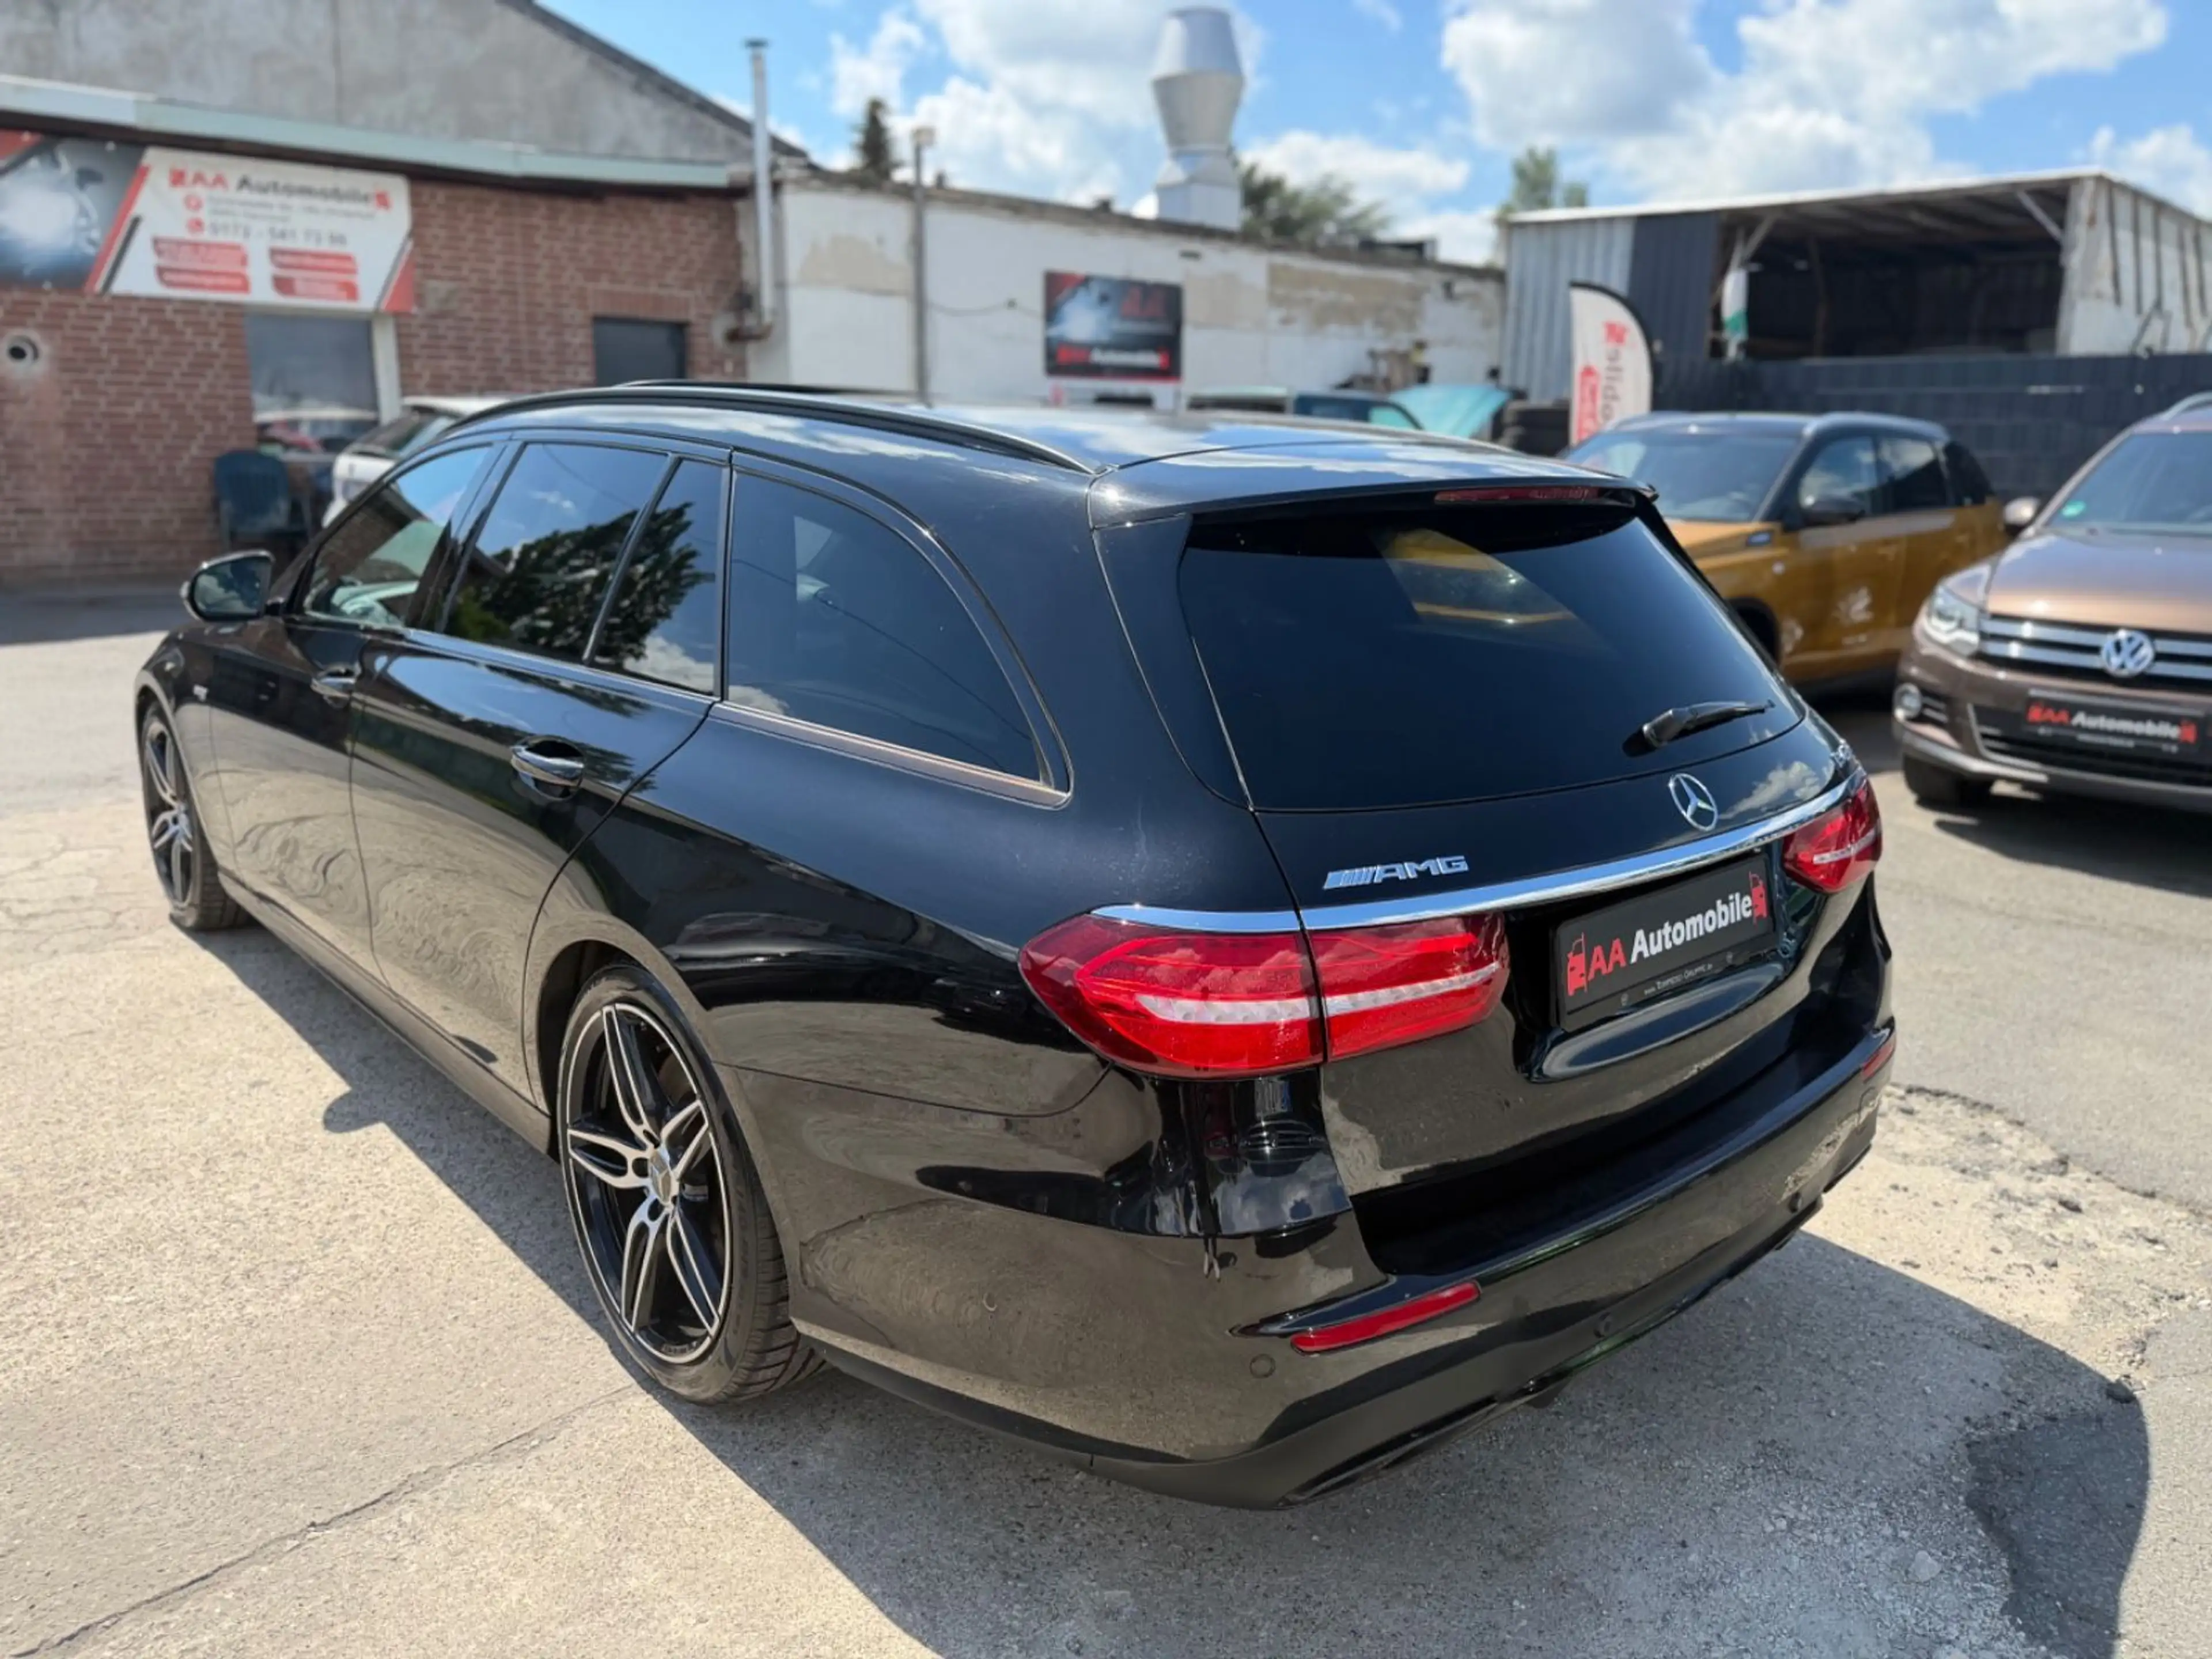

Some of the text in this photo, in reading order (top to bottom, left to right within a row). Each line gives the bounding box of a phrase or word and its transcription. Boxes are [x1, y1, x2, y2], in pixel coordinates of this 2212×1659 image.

[192, 171, 228, 191] AA
[2071, 711, 2181, 740] Automobile
[1373, 855, 1469, 883] AMG
[1588, 938, 1627, 981] AA
[1630, 892, 1753, 964] Automobile
